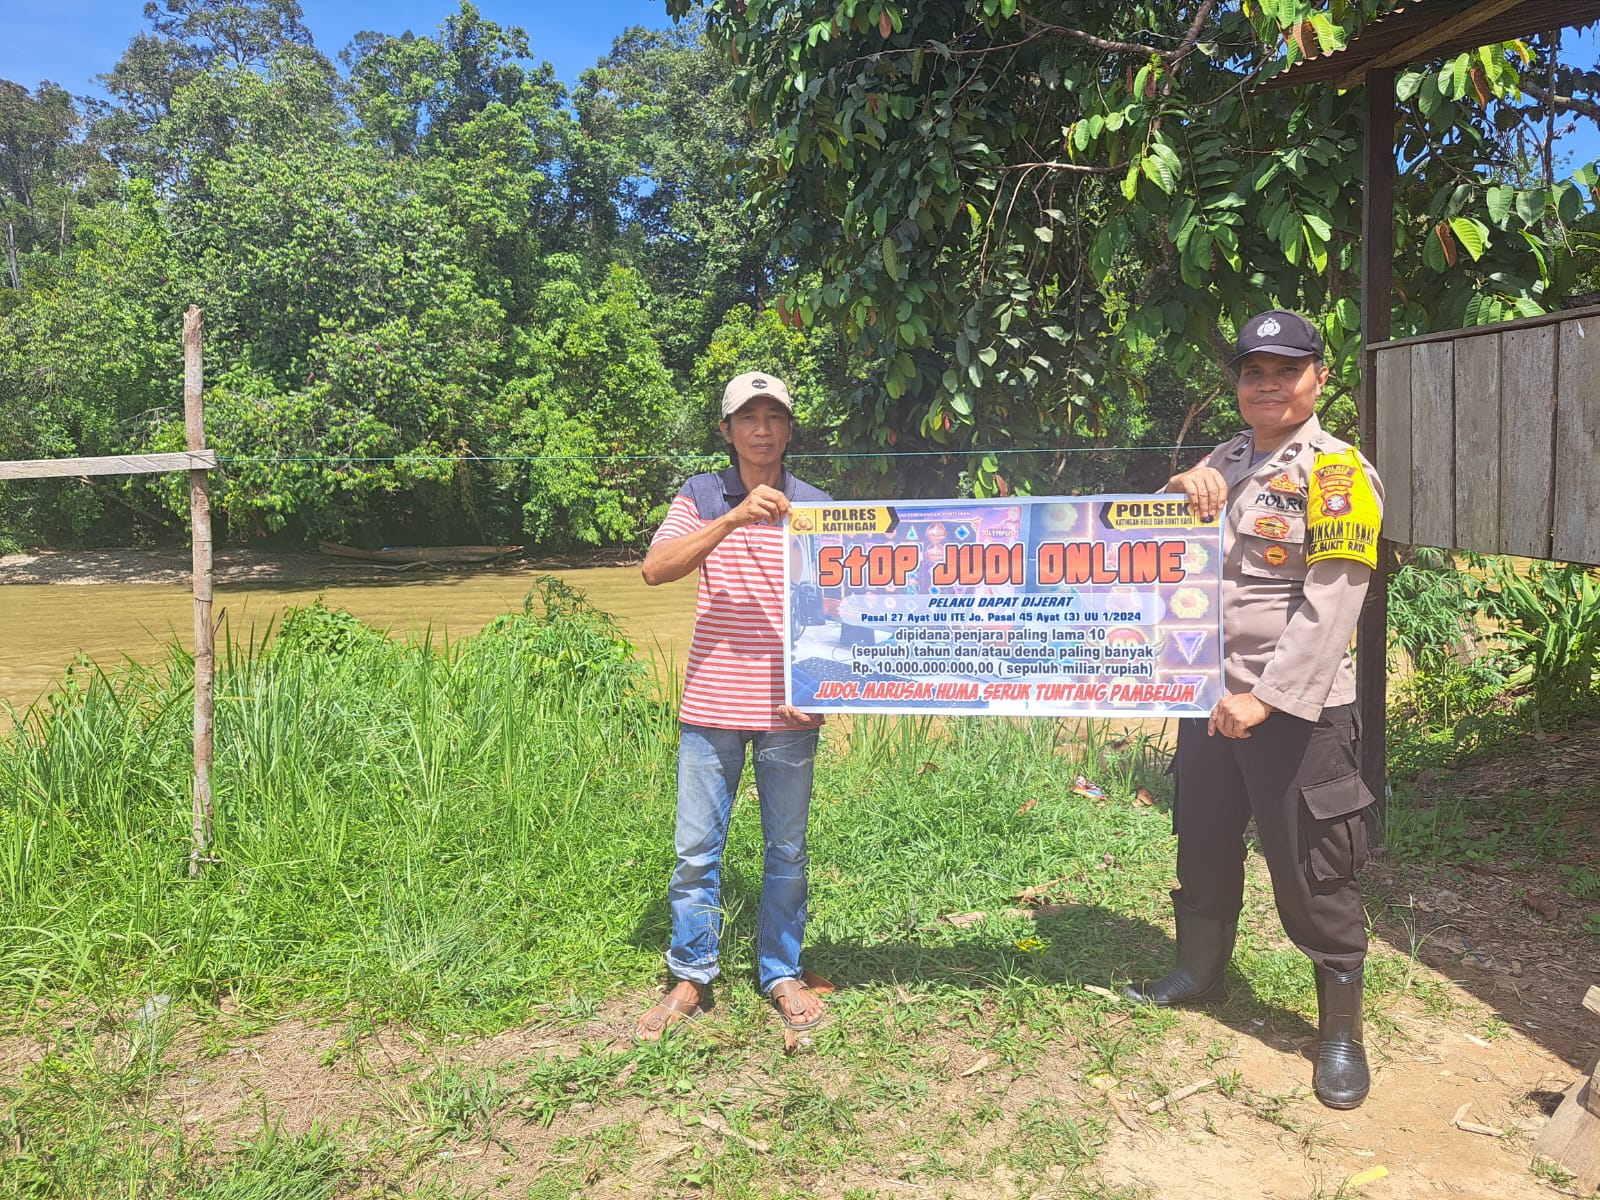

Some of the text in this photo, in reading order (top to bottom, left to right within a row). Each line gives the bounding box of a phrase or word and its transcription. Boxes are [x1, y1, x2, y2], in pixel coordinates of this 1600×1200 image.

[1255, 493, 1303, 511] POLRI
[823, 509, 876, 521] POLRES
[1117, 503, 1190, 517] POLSEK
[823, 522, 876, 531] KATINGAN
[932, 543, 1024, 586] JUDI
[1037, 541, 1186, 585] ONLINE
[928, 597, 1073, 608] PELAKU DAPAT DIJERAT
[861, 612, 1141, 623] Pasal 27 Ayat UU ITE Jo. Pasal 45 Ayat (3) UU 1/2024
[895, 629, 1105, 643] dipidana penjara paling lama 10
[852, 645, 1153, 660] (sepuluh) tahun dan/atau denda paling banyak
[853, 662, 873, 675] Rp.
[876, 662, 994, 676] 10.000.000.000,00
[1007, 662, 1058, 676] sepuluh
[1063, 663, 1100, 674] miliar
[1105, 663, 1153, 677] rupiah)
[815, 682, 1196, 702] JUDOL MARUSAK HUMA SERUK TUNTANG PAMBELUM
